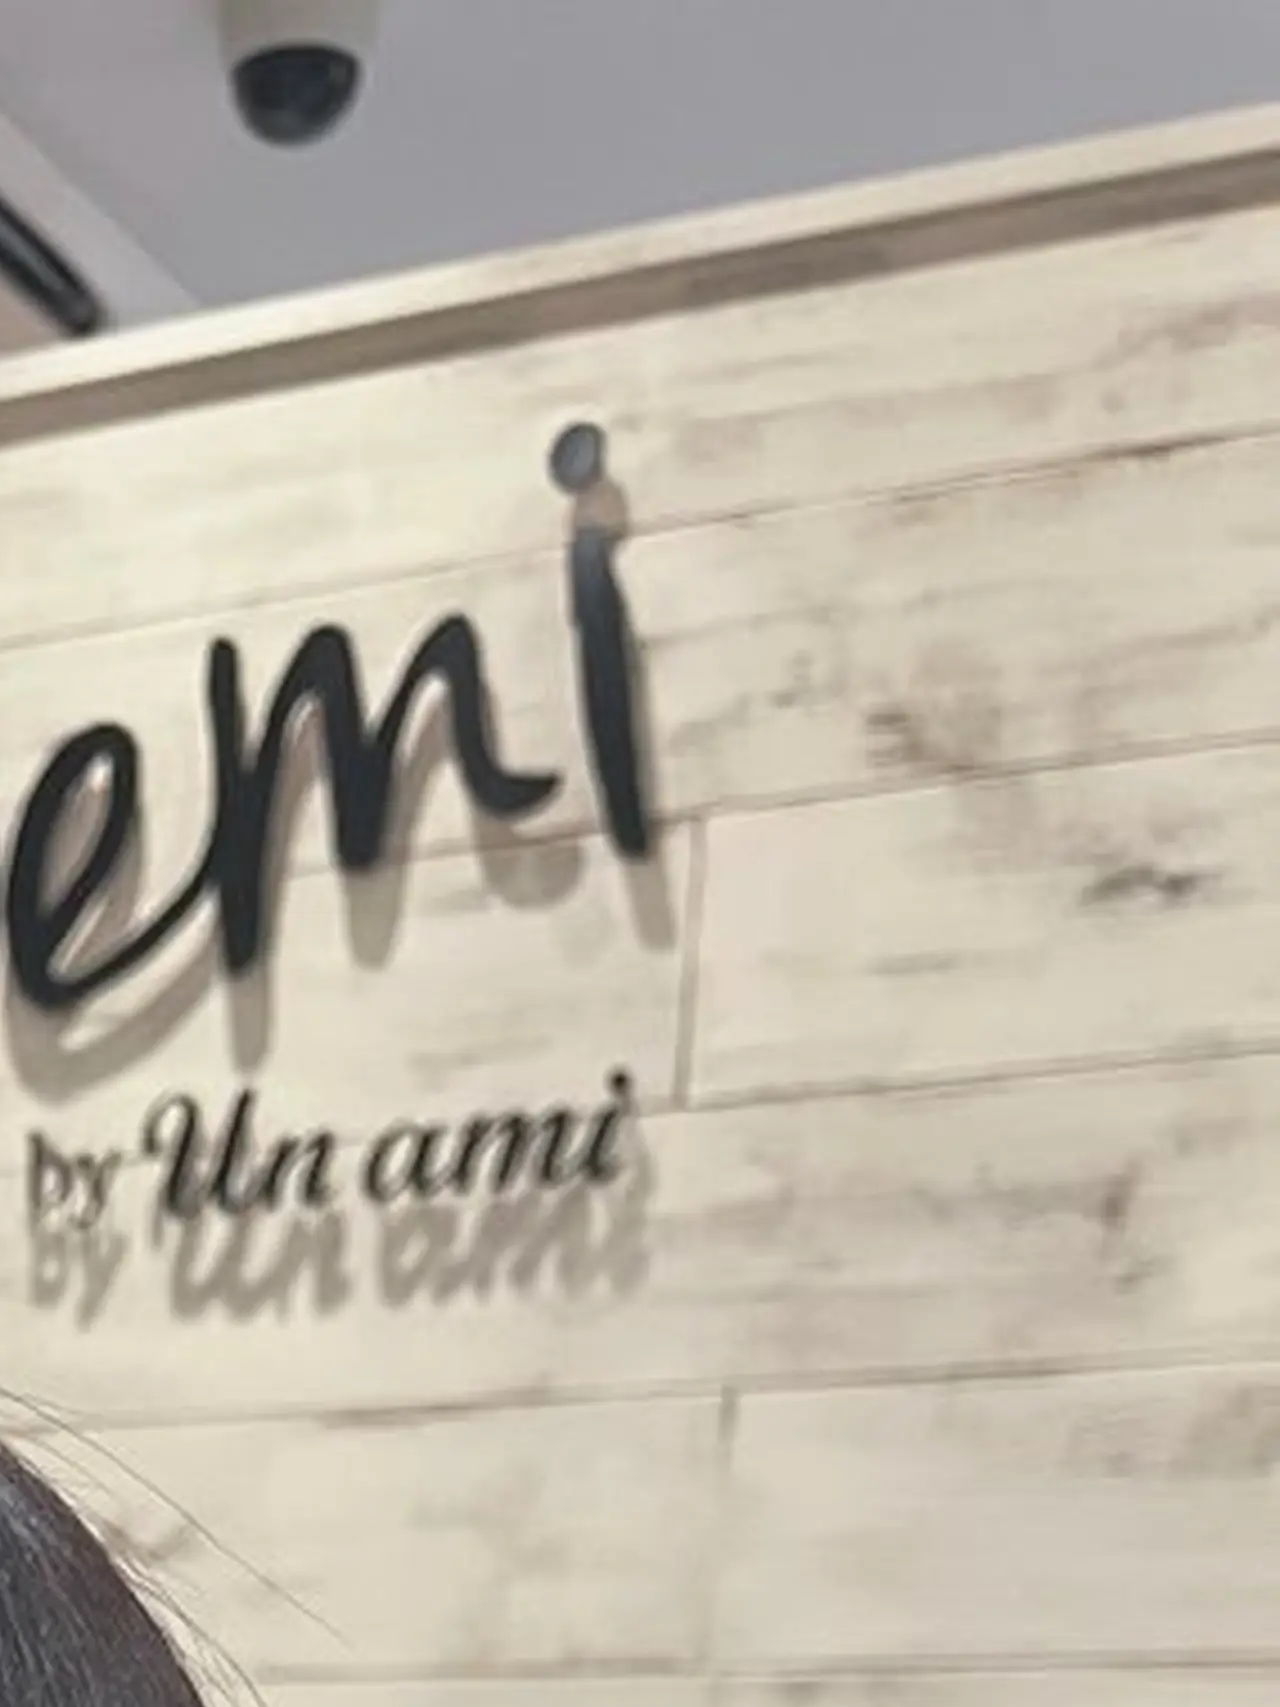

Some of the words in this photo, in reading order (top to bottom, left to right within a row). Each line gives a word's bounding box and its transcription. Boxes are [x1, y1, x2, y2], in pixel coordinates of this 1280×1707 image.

[26, 1131, 122, 1229] by
[142, 1088, 338, 1219] Un
[361, 1066, 638, 1203] ami
